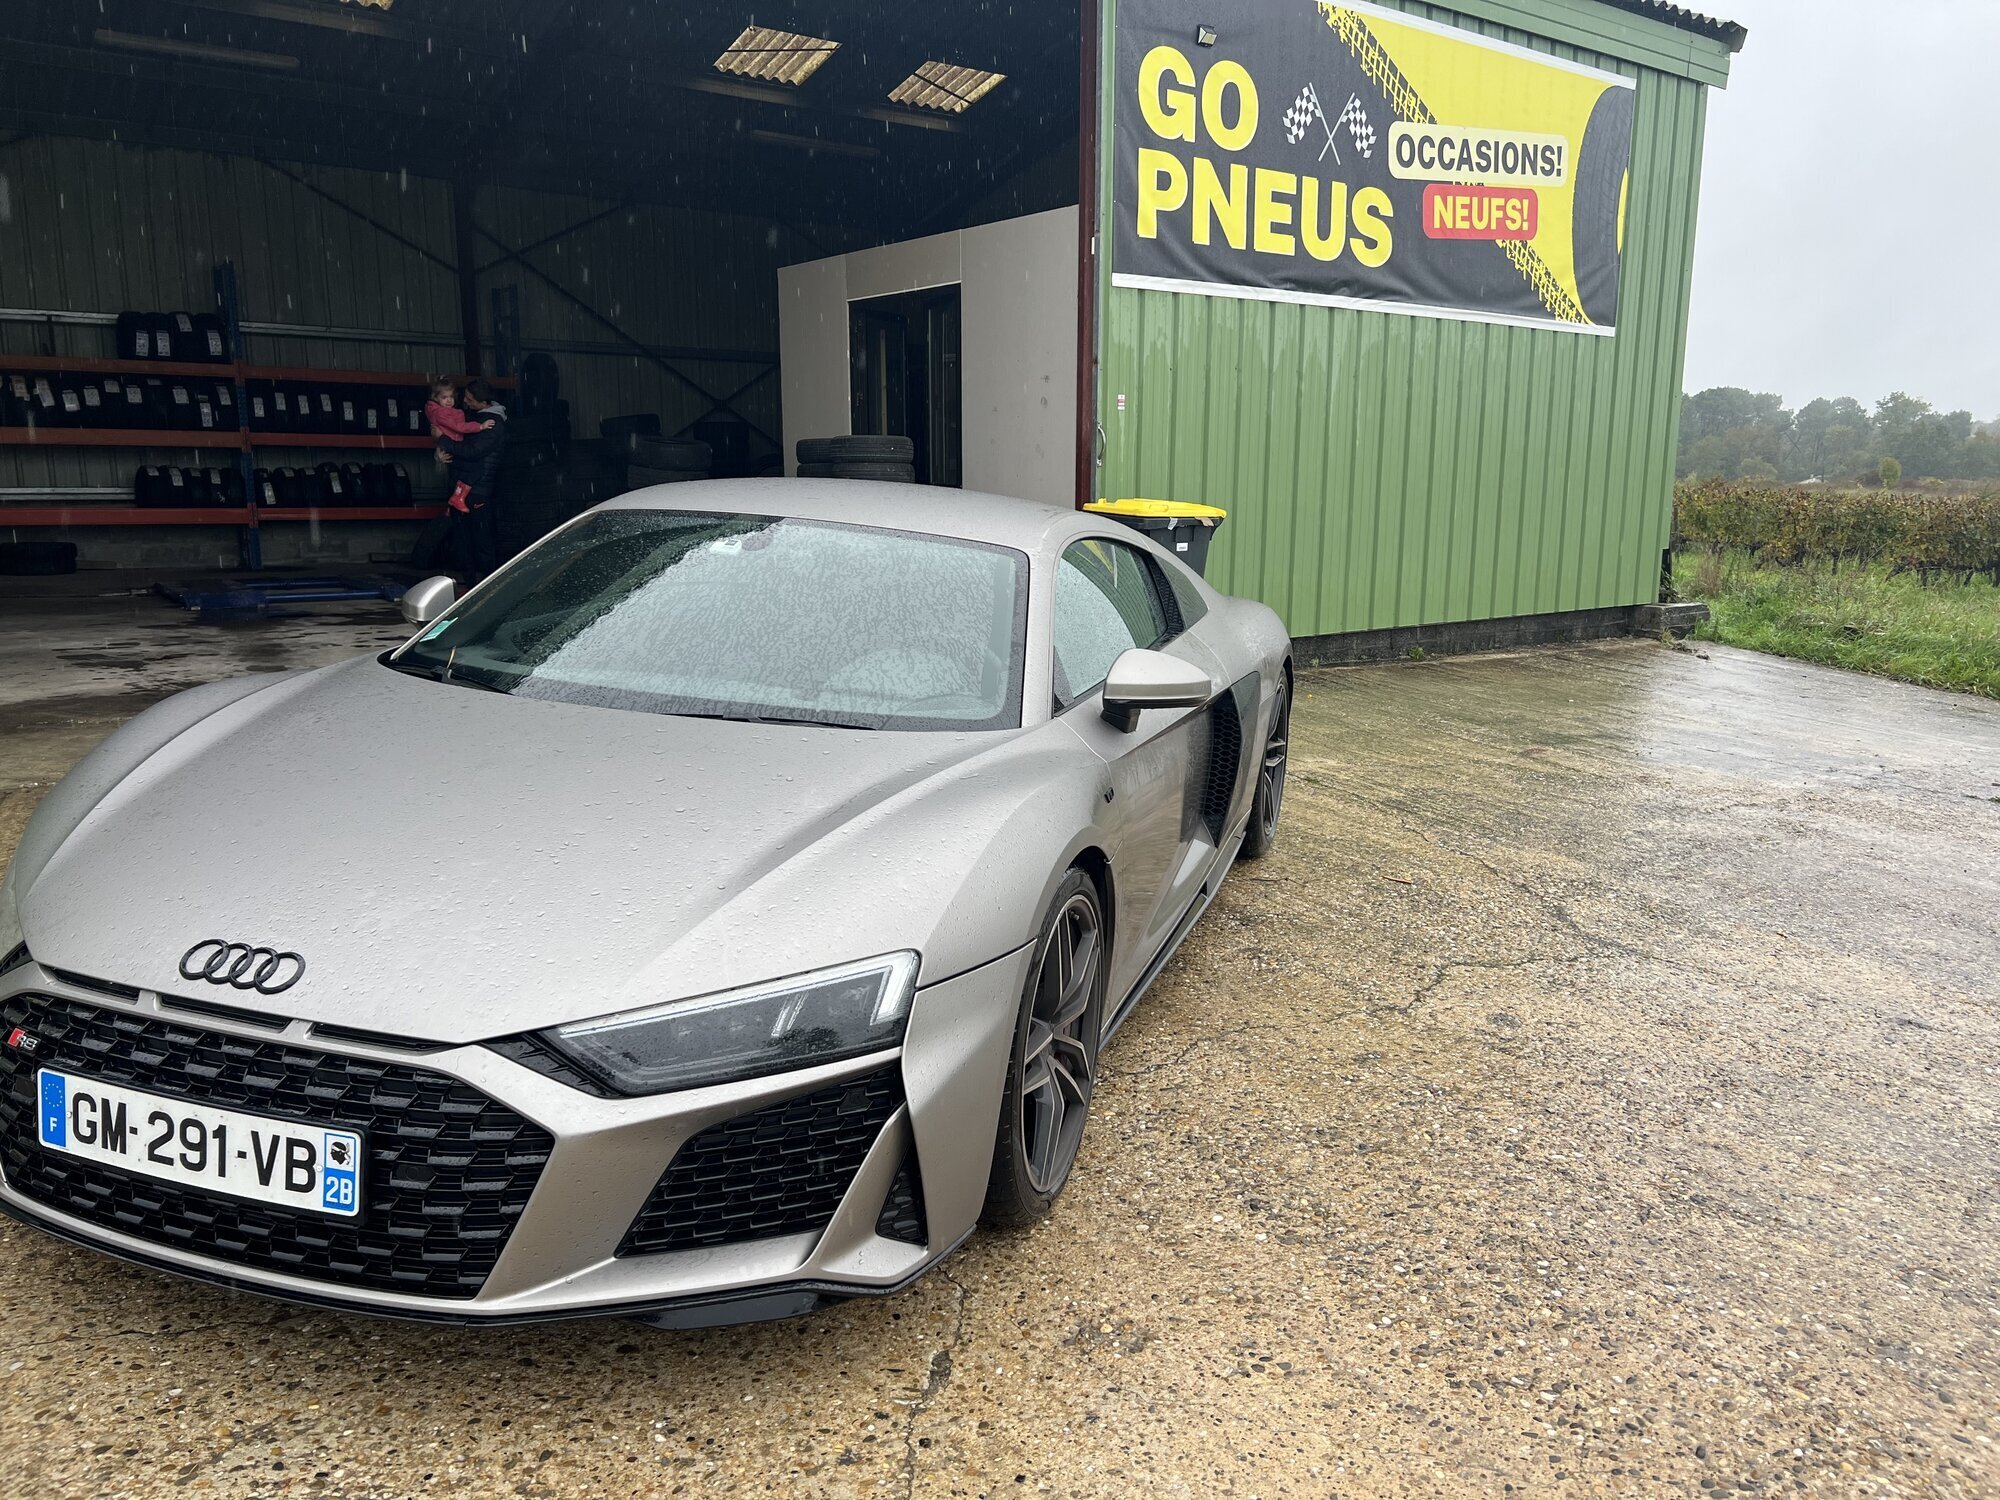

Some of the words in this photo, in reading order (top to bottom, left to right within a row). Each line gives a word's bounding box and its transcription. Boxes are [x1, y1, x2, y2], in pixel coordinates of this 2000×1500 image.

[1138, 45, 1259, 151] GO
[1396, 133, 1563, 177] OCCASIONS!
[1137, 147, 1394, 268] PNEUS
[1433, 195, 1529, 231] NEUFS!
[50, 1116, 58, 1132] F
[72, 1092, 317, 1194] GM-291-VB
[325, 1176, 353, 1205] 2B
